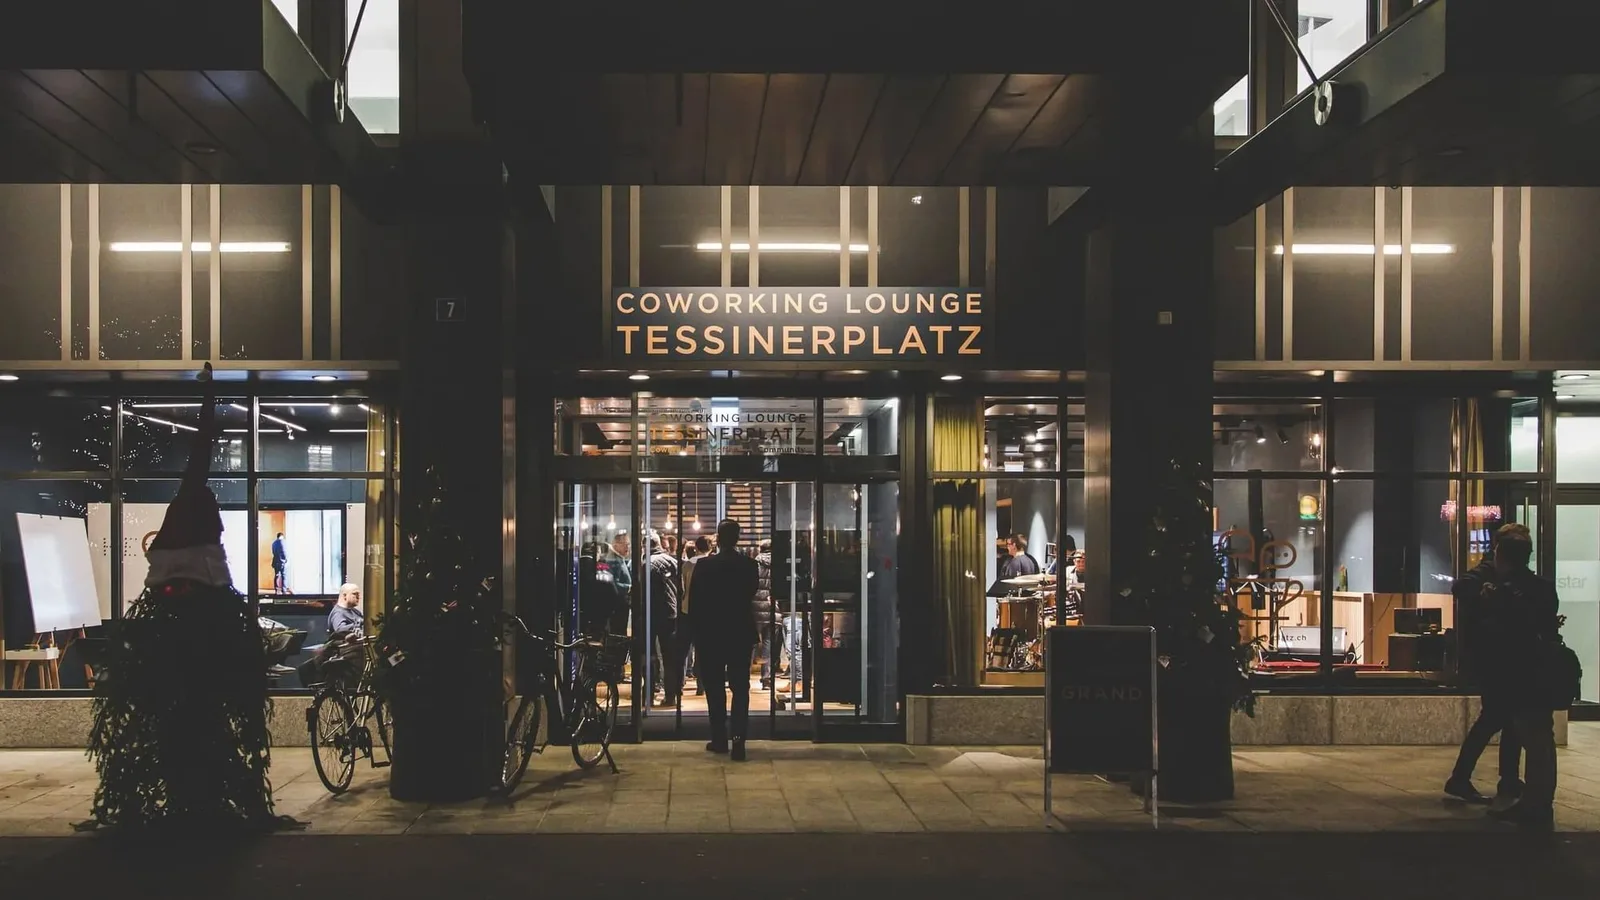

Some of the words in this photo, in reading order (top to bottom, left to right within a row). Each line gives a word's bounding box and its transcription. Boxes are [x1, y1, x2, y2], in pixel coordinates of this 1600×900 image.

[447, 302, 455, 318] 7
[616, 292, 828, 314] COWORKING
[845, 292, 982, 314] LOUNGE
[616, 324, 982, 355] TESSINERPLATZ
[651, 413, 740, 423] OWORKING
[747, 413, 806, 423] LOUNGE
[1061, 685, 1142, 701] GRAND
